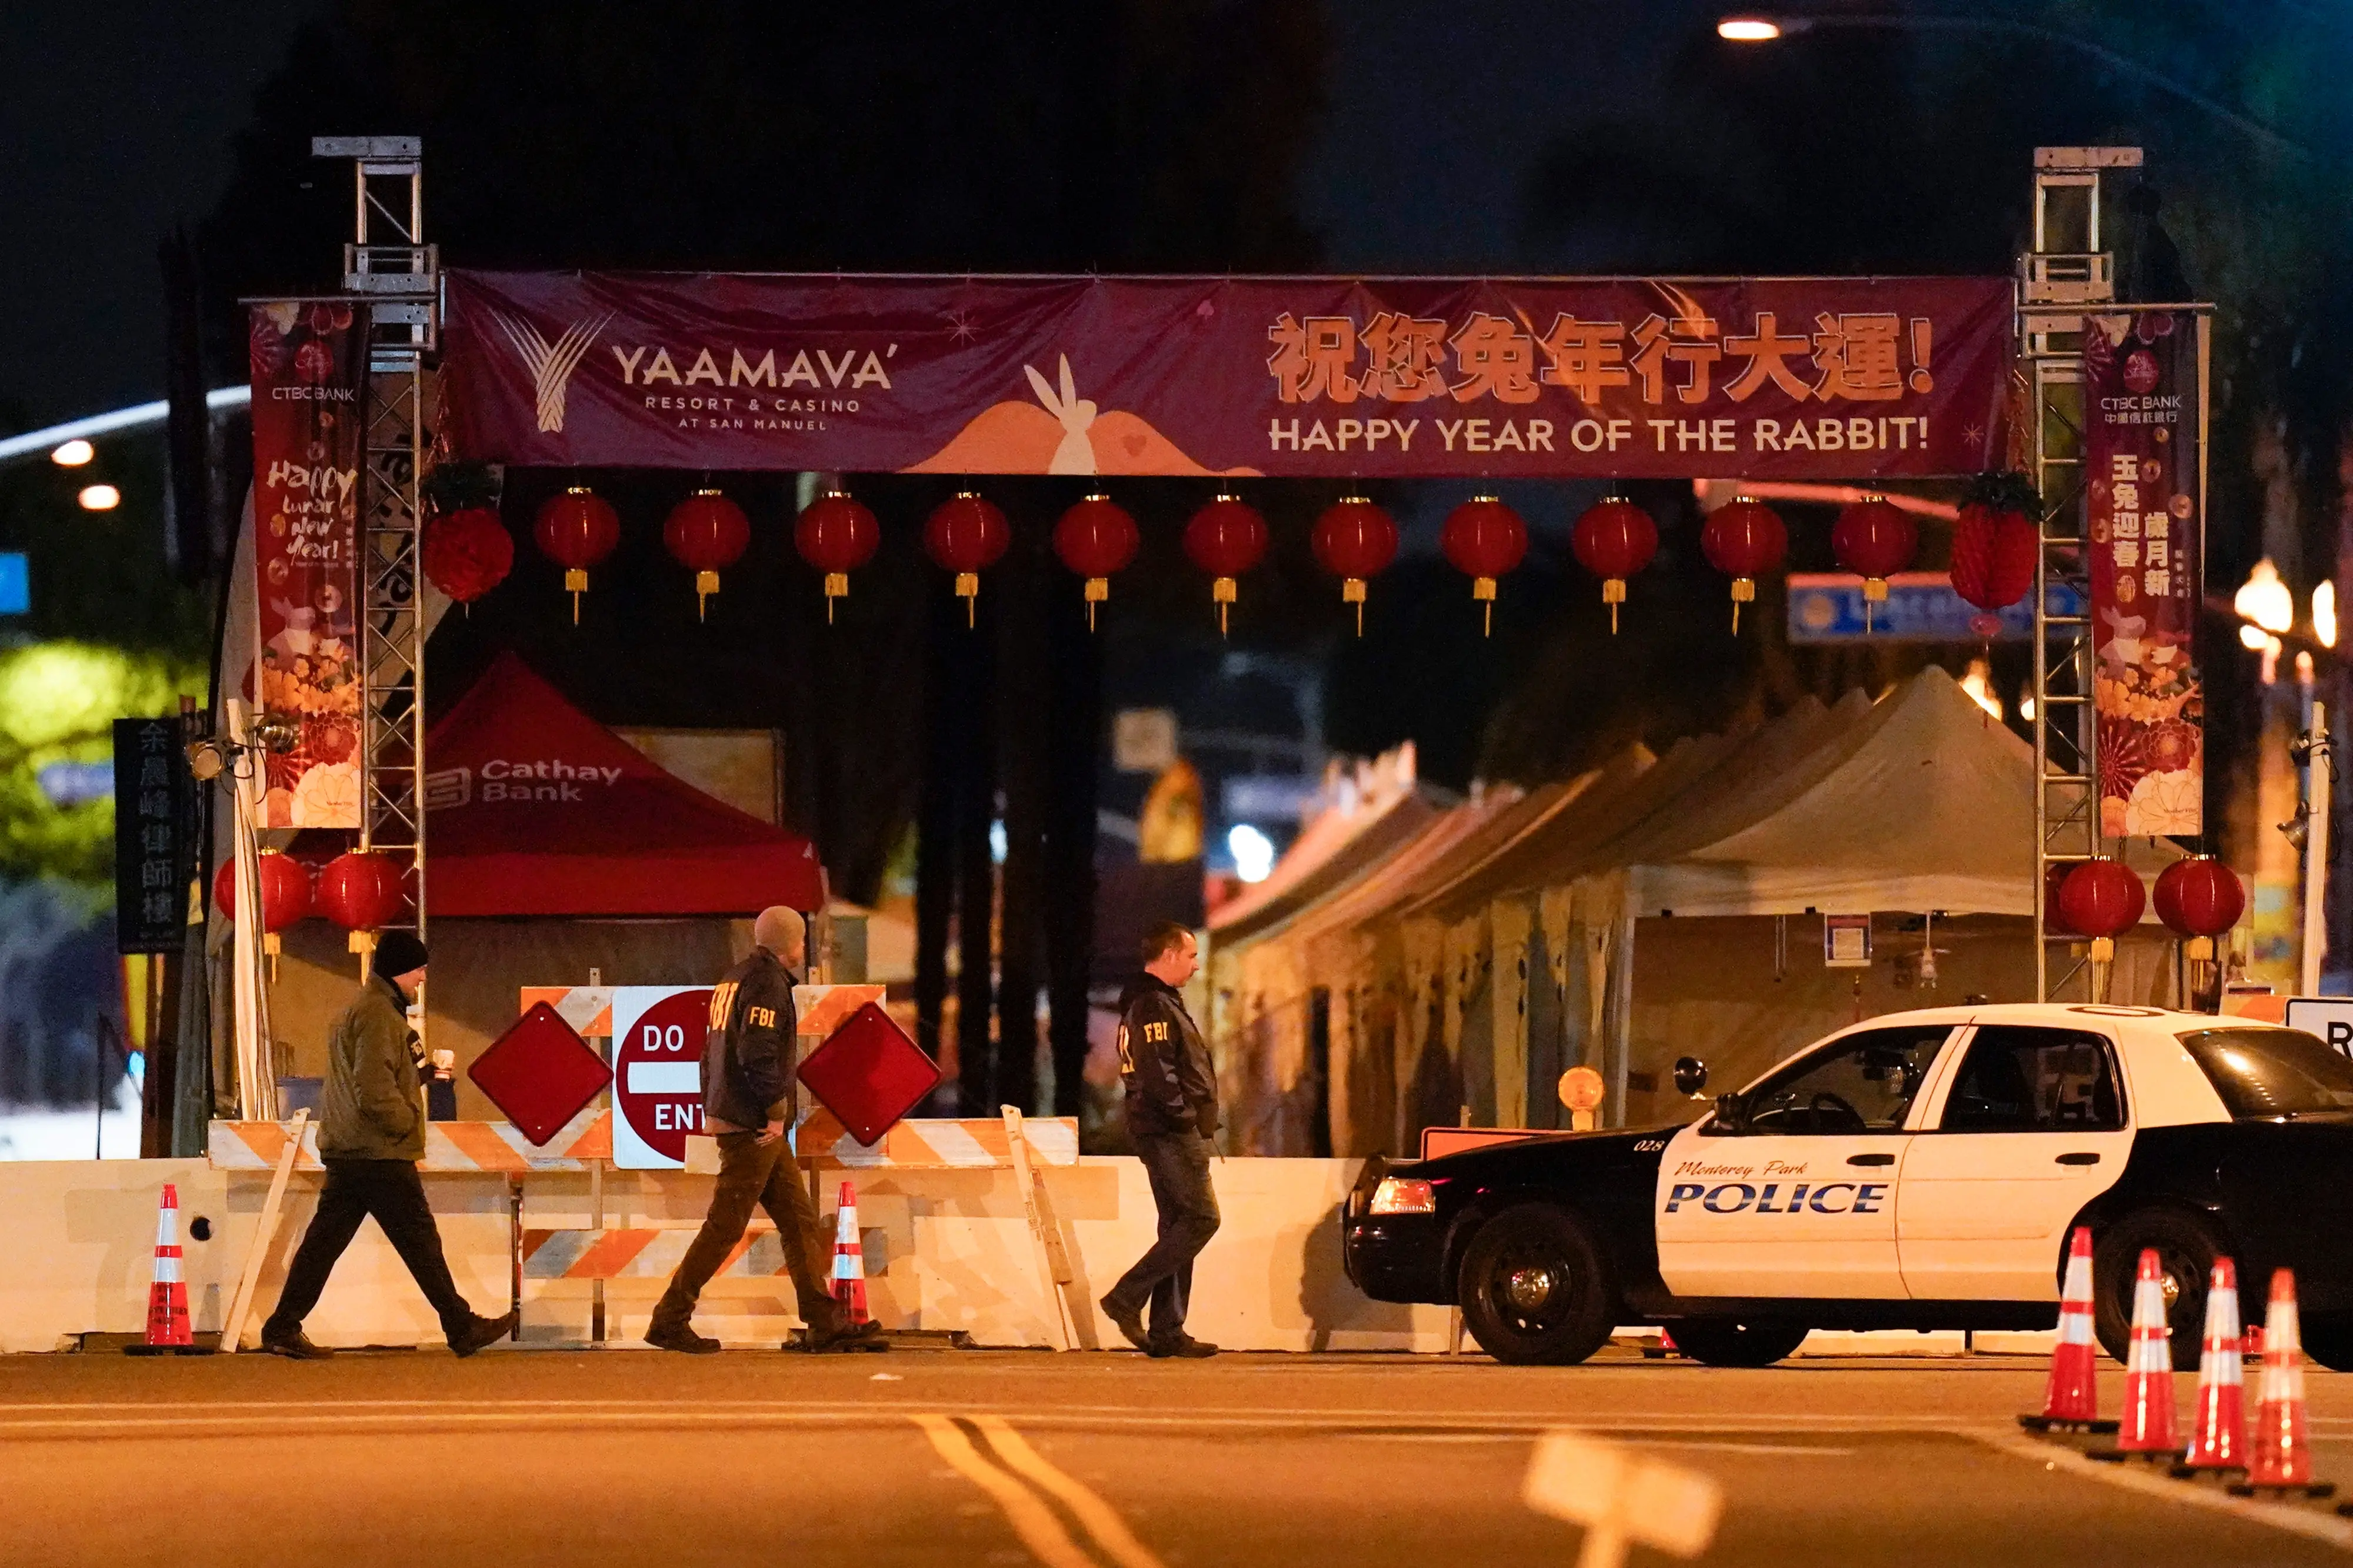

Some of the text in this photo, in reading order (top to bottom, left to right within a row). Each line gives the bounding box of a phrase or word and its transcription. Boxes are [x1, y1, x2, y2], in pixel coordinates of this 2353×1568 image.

[1267, 312, 1934, 404] 祝您兔年行大運!
[272, 386, 355, 401] CTBC BANK
[645, 396, 859, 412] RESORT & CASINO
[2101, 395, 2181, 411] CTBC BANK
[678, 418, 826, 431] AT SAN MANUEL
[1268, 416, 1928, 452] HAPPY YEAR OF THE RABBIT!
[266, 459, 359, 509] Happy
[2112, 454, 2140, 568] 玉兔迎春
[481, 759, 622, 786] Cathay
[482, 782, 583, 802] Bank
[749, 1006, 776, 1027] FBI
[643, 1025, 684, 1052] DO
[1144, 1022, 1168, 1043] FBI
[1634, 1140, 1665, 1152] 028
[1674, 1160, 1808, 1179] Monterey Park
[1664, 1183, 1889, 1213] POLICE
